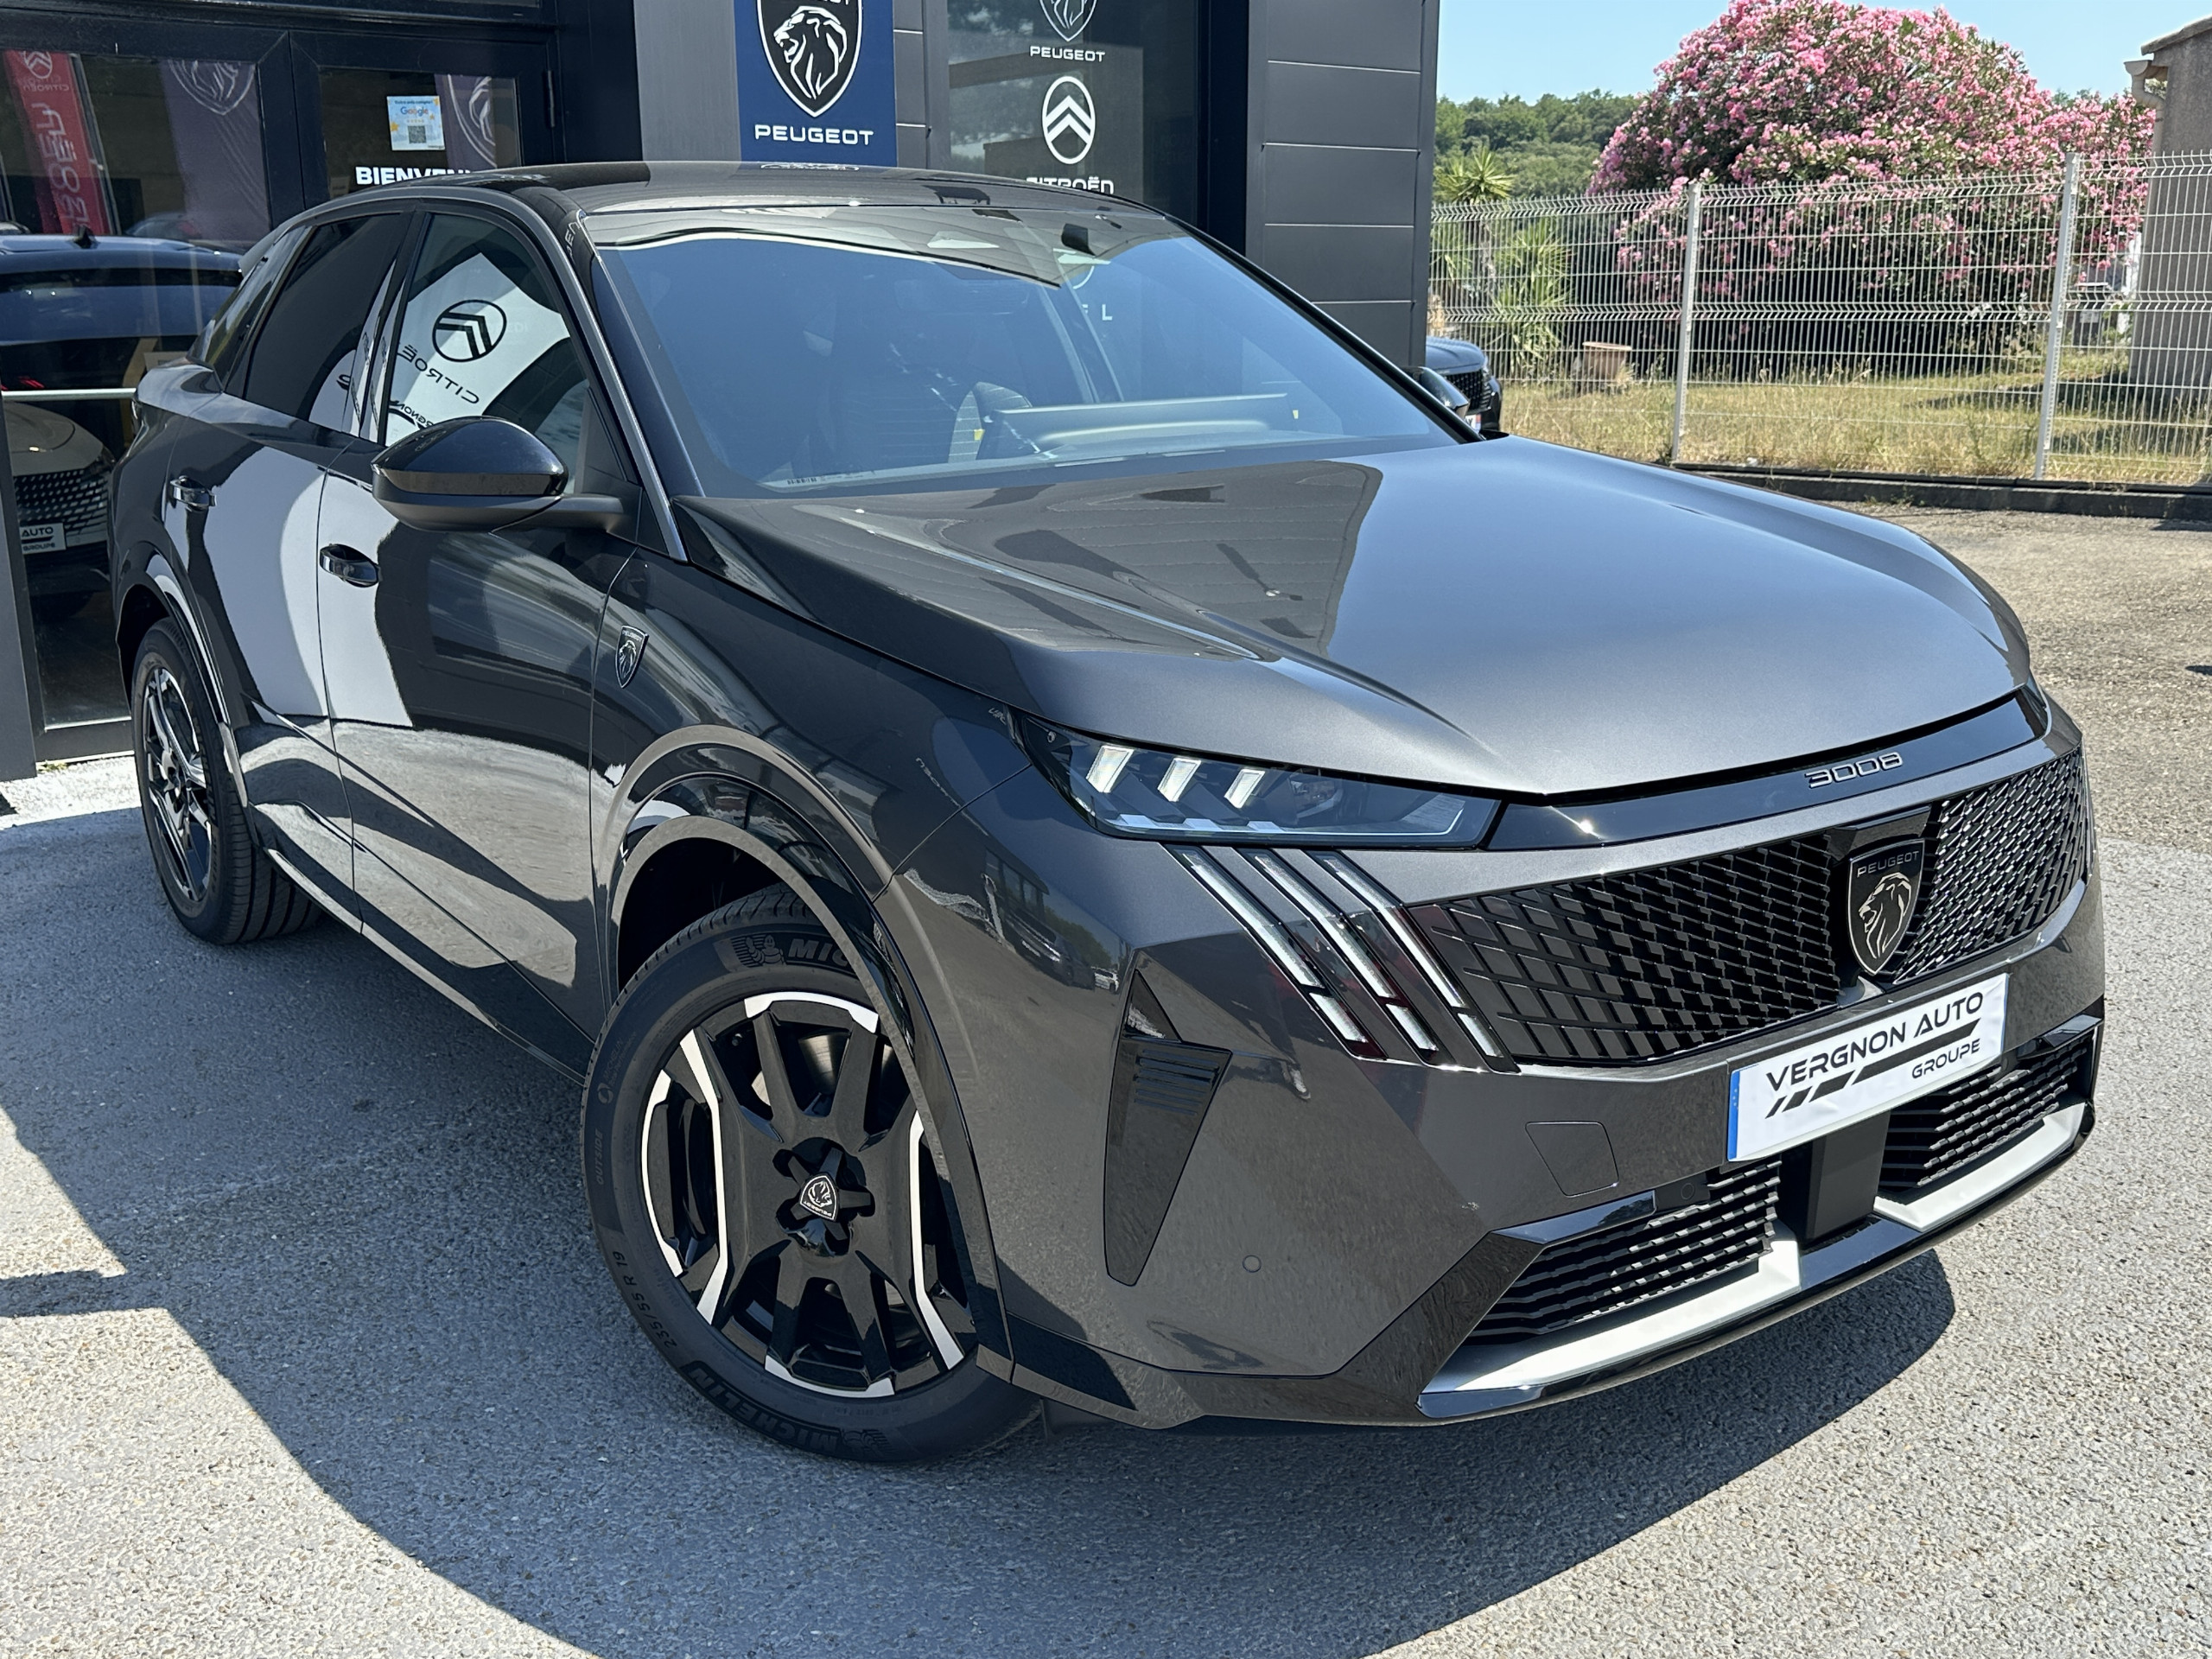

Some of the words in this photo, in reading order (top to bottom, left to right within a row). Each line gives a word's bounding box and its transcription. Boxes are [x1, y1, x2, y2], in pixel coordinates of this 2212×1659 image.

[1030, 46, 1105, 62] PEUGEOT
[400, 106, 429, 116] Google
[754, 124, 874, 146] PEUGEOT
[355, 166, 471, 185] BIENV
[22, 526, 54, 537] AUTO
[22, 542, 55, 551] GROUPE
[1805, 752, 1904, 788] 3008
[1857, 850, 1920, 878] PEUGEOT
[1765, 1021, 1907, 1092] VERGNON
[1913, 992, 1984, 1039] AUTO
[1911, 1038, 1981, 1079] GROUPE
[613, 1250, 628, 1268] 19
[623, 1274, 638, 1287] R
[631, 1292, 677, 1349] 235/55
[690, 1365, 841, 1452] MICHELIN
